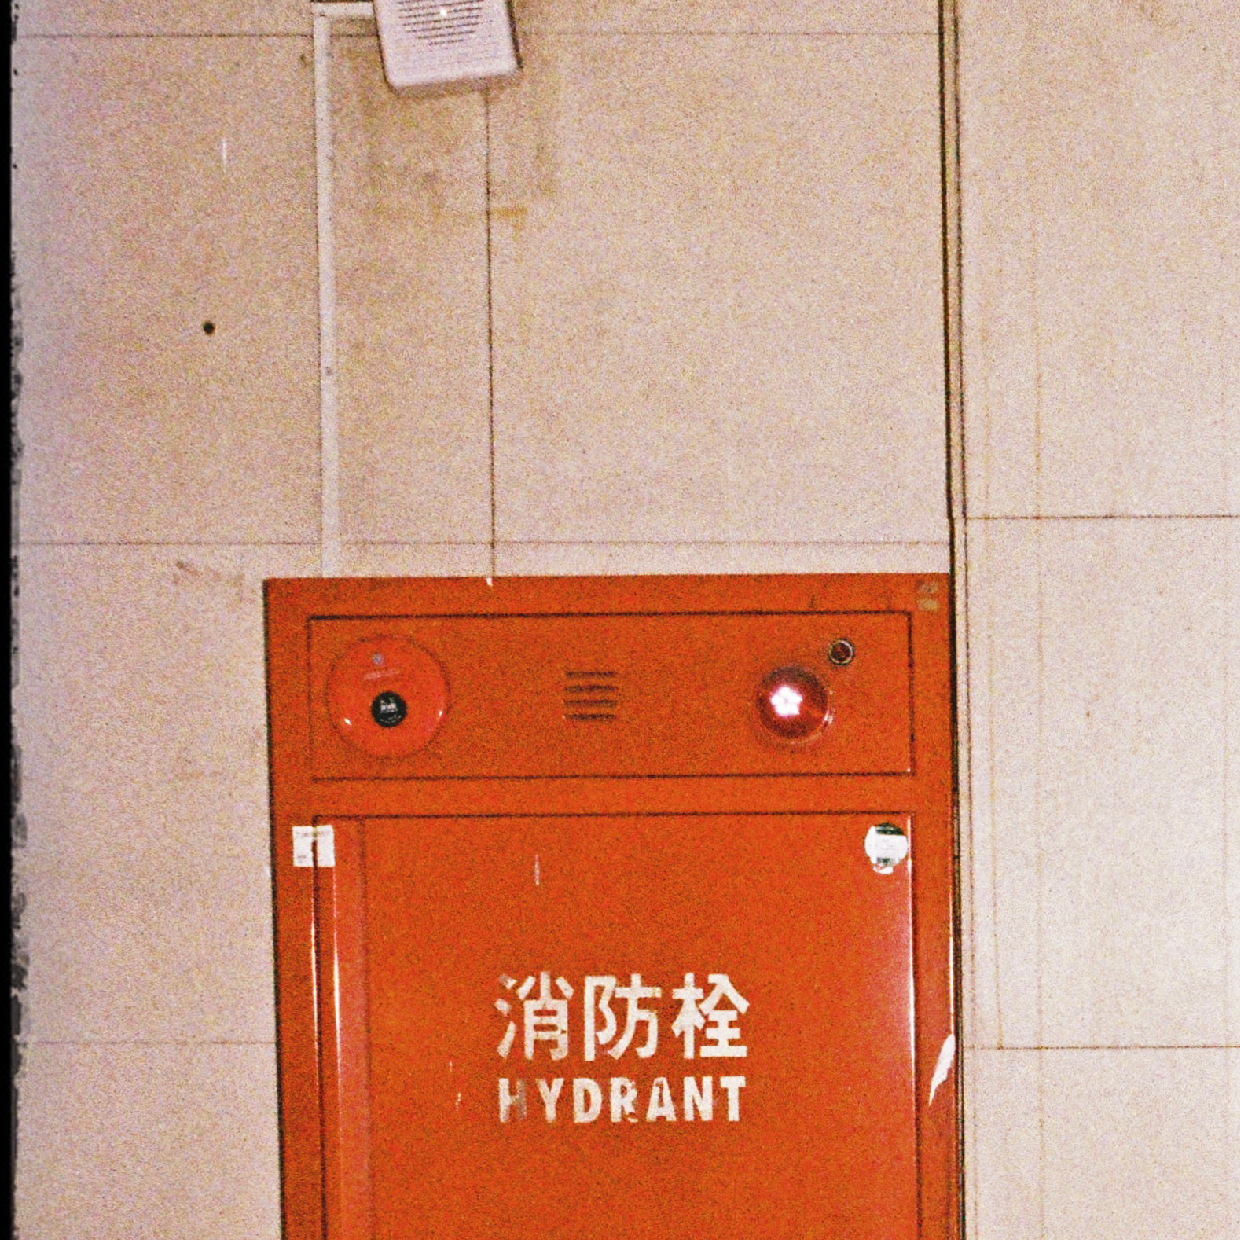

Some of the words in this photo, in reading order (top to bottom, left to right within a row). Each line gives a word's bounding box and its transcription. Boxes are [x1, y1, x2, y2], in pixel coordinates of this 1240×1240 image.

[494, 972, 750, 1061] 消防栓
[499, 1075, 747, 1124] HYDRANT
